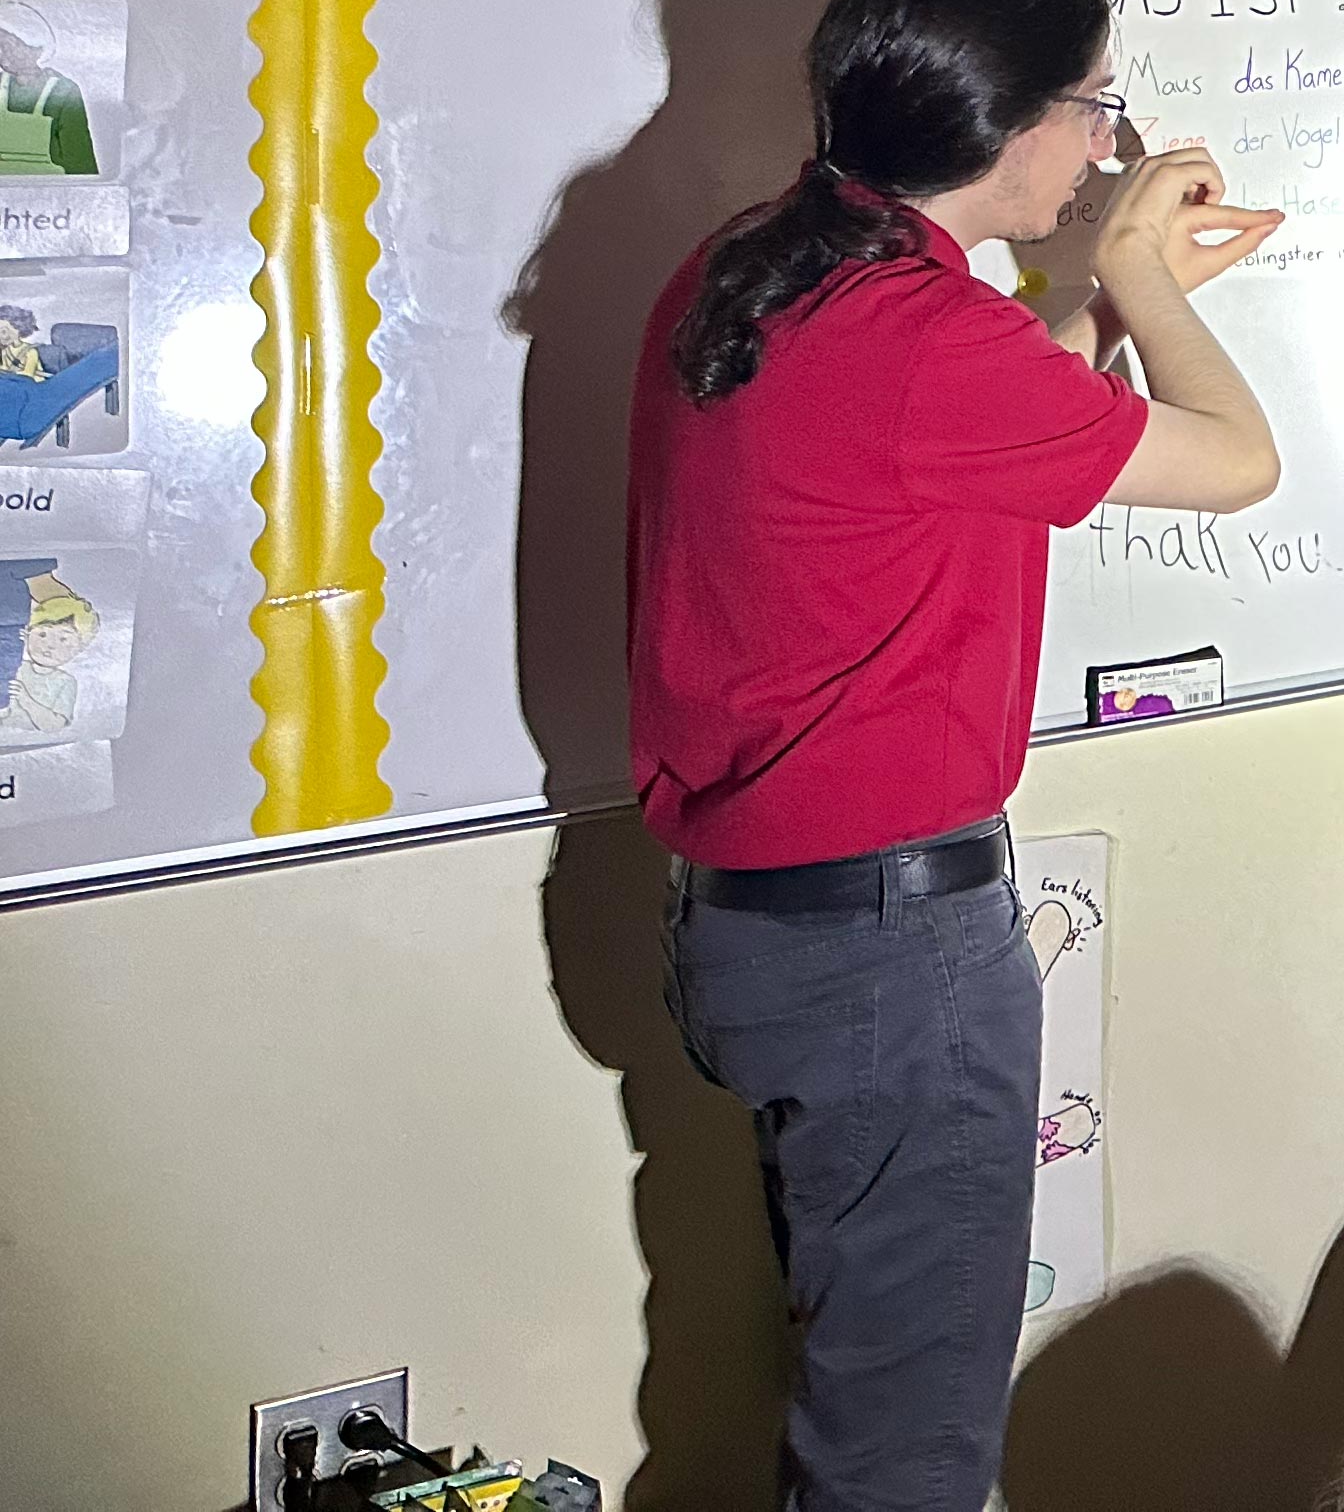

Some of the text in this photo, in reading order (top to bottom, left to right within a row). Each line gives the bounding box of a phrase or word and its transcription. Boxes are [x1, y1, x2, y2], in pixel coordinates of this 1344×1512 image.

[1123, 52, 1203, 98] Maus
[1234, 46, 1274, 94] das
[1233, 117, 1273, 155] der
[1281, 113, 1341, 169] Vogel
[0, 207, 71, 231] hted
[1056, 201, 1099, 227] die
[1282, 184, 1344, 217] Hase
[1117, 670, 1171, 683] Multi-Purpose
[1172, 666, 1198, 676] Eraser
[1041, 877, 1104, 929] Ears listening
